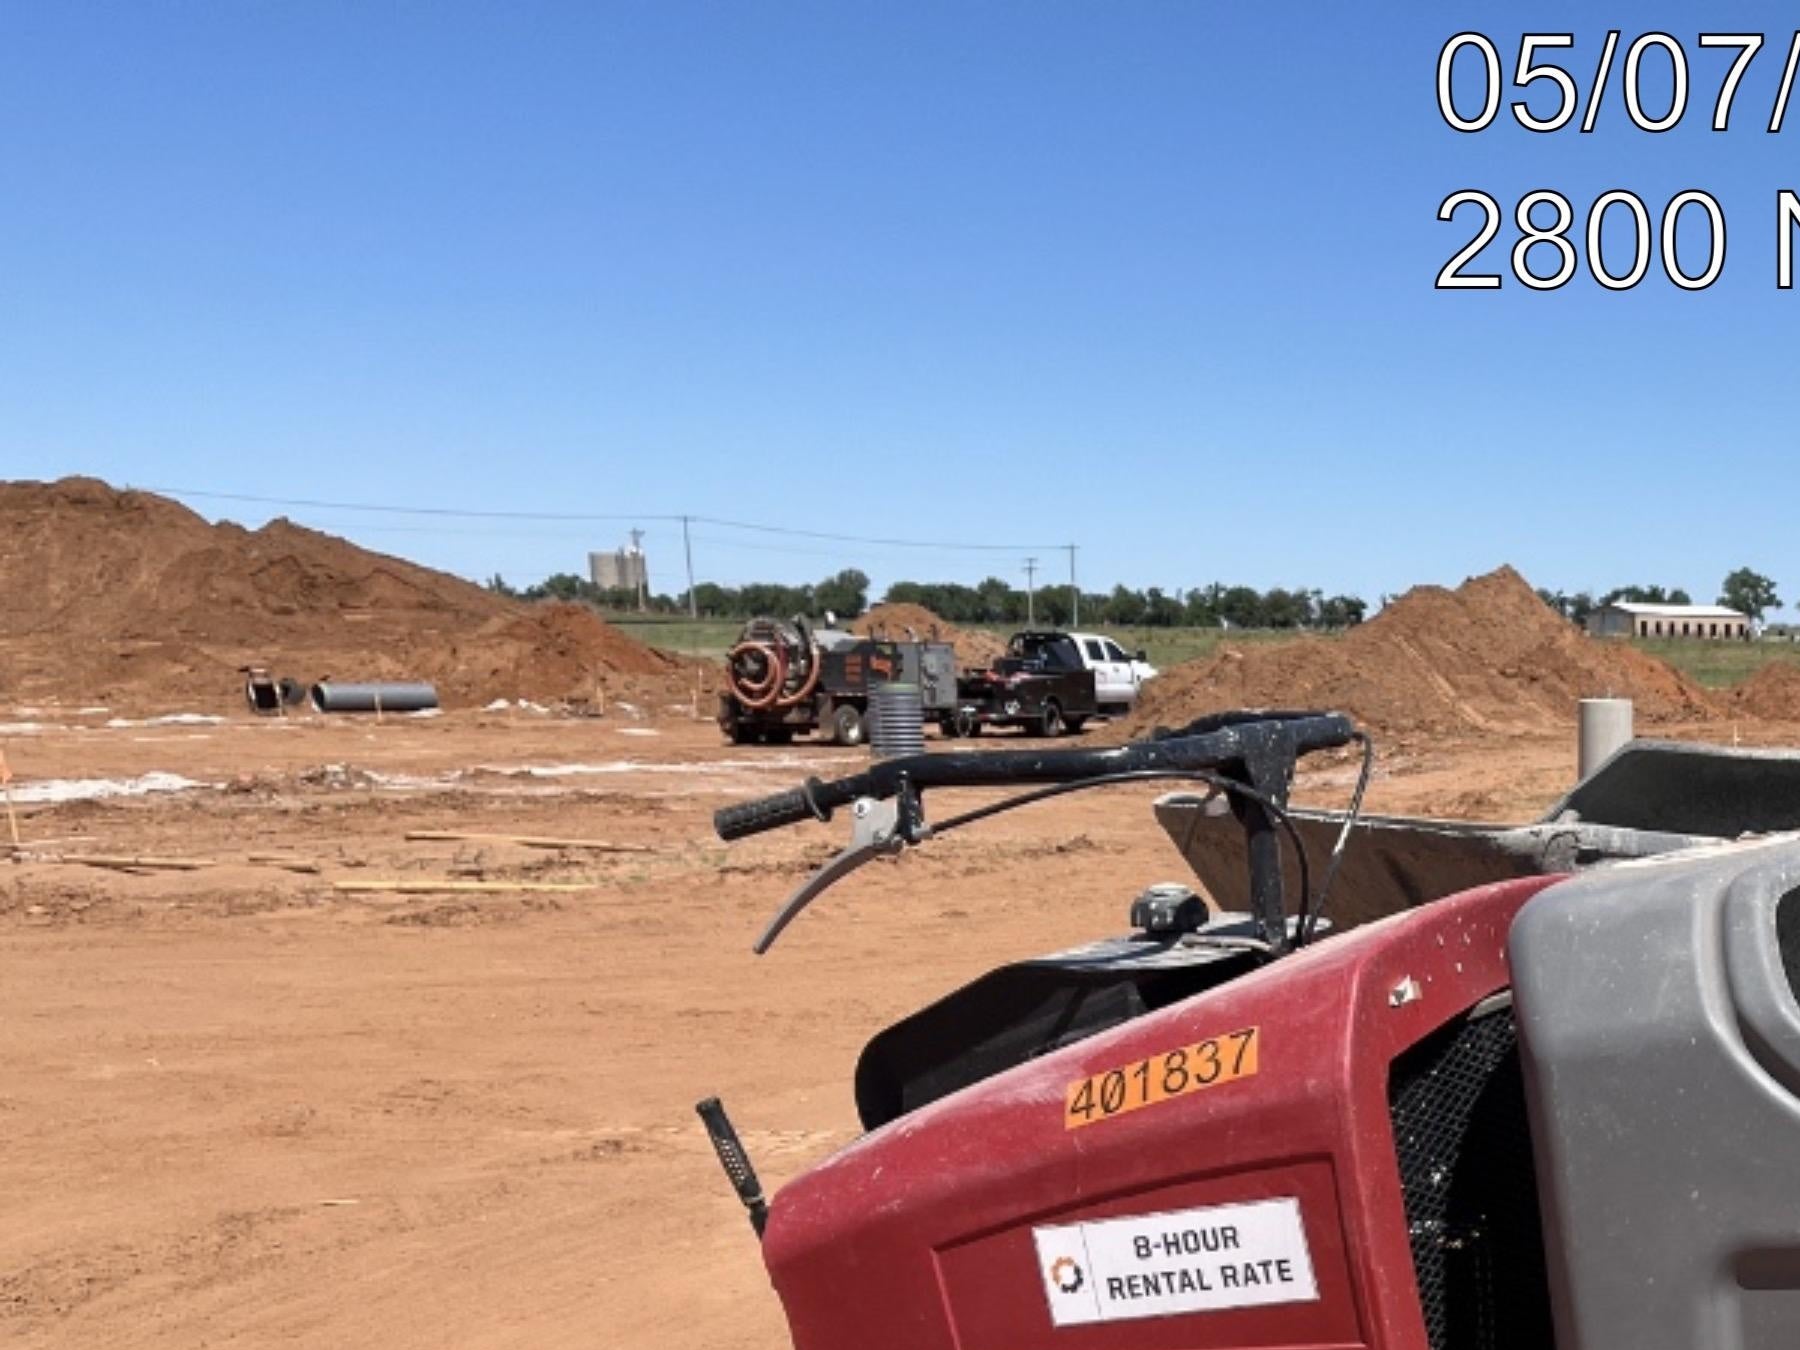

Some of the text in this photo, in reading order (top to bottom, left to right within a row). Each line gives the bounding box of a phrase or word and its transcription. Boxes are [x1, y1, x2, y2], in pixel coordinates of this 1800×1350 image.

[1070, 1028, 1255, 1120] 401837
[1133, 1226, 1240, 1259] 8-HOUR
[1107, 1259, 1294, 1300] RENTAL RATE
